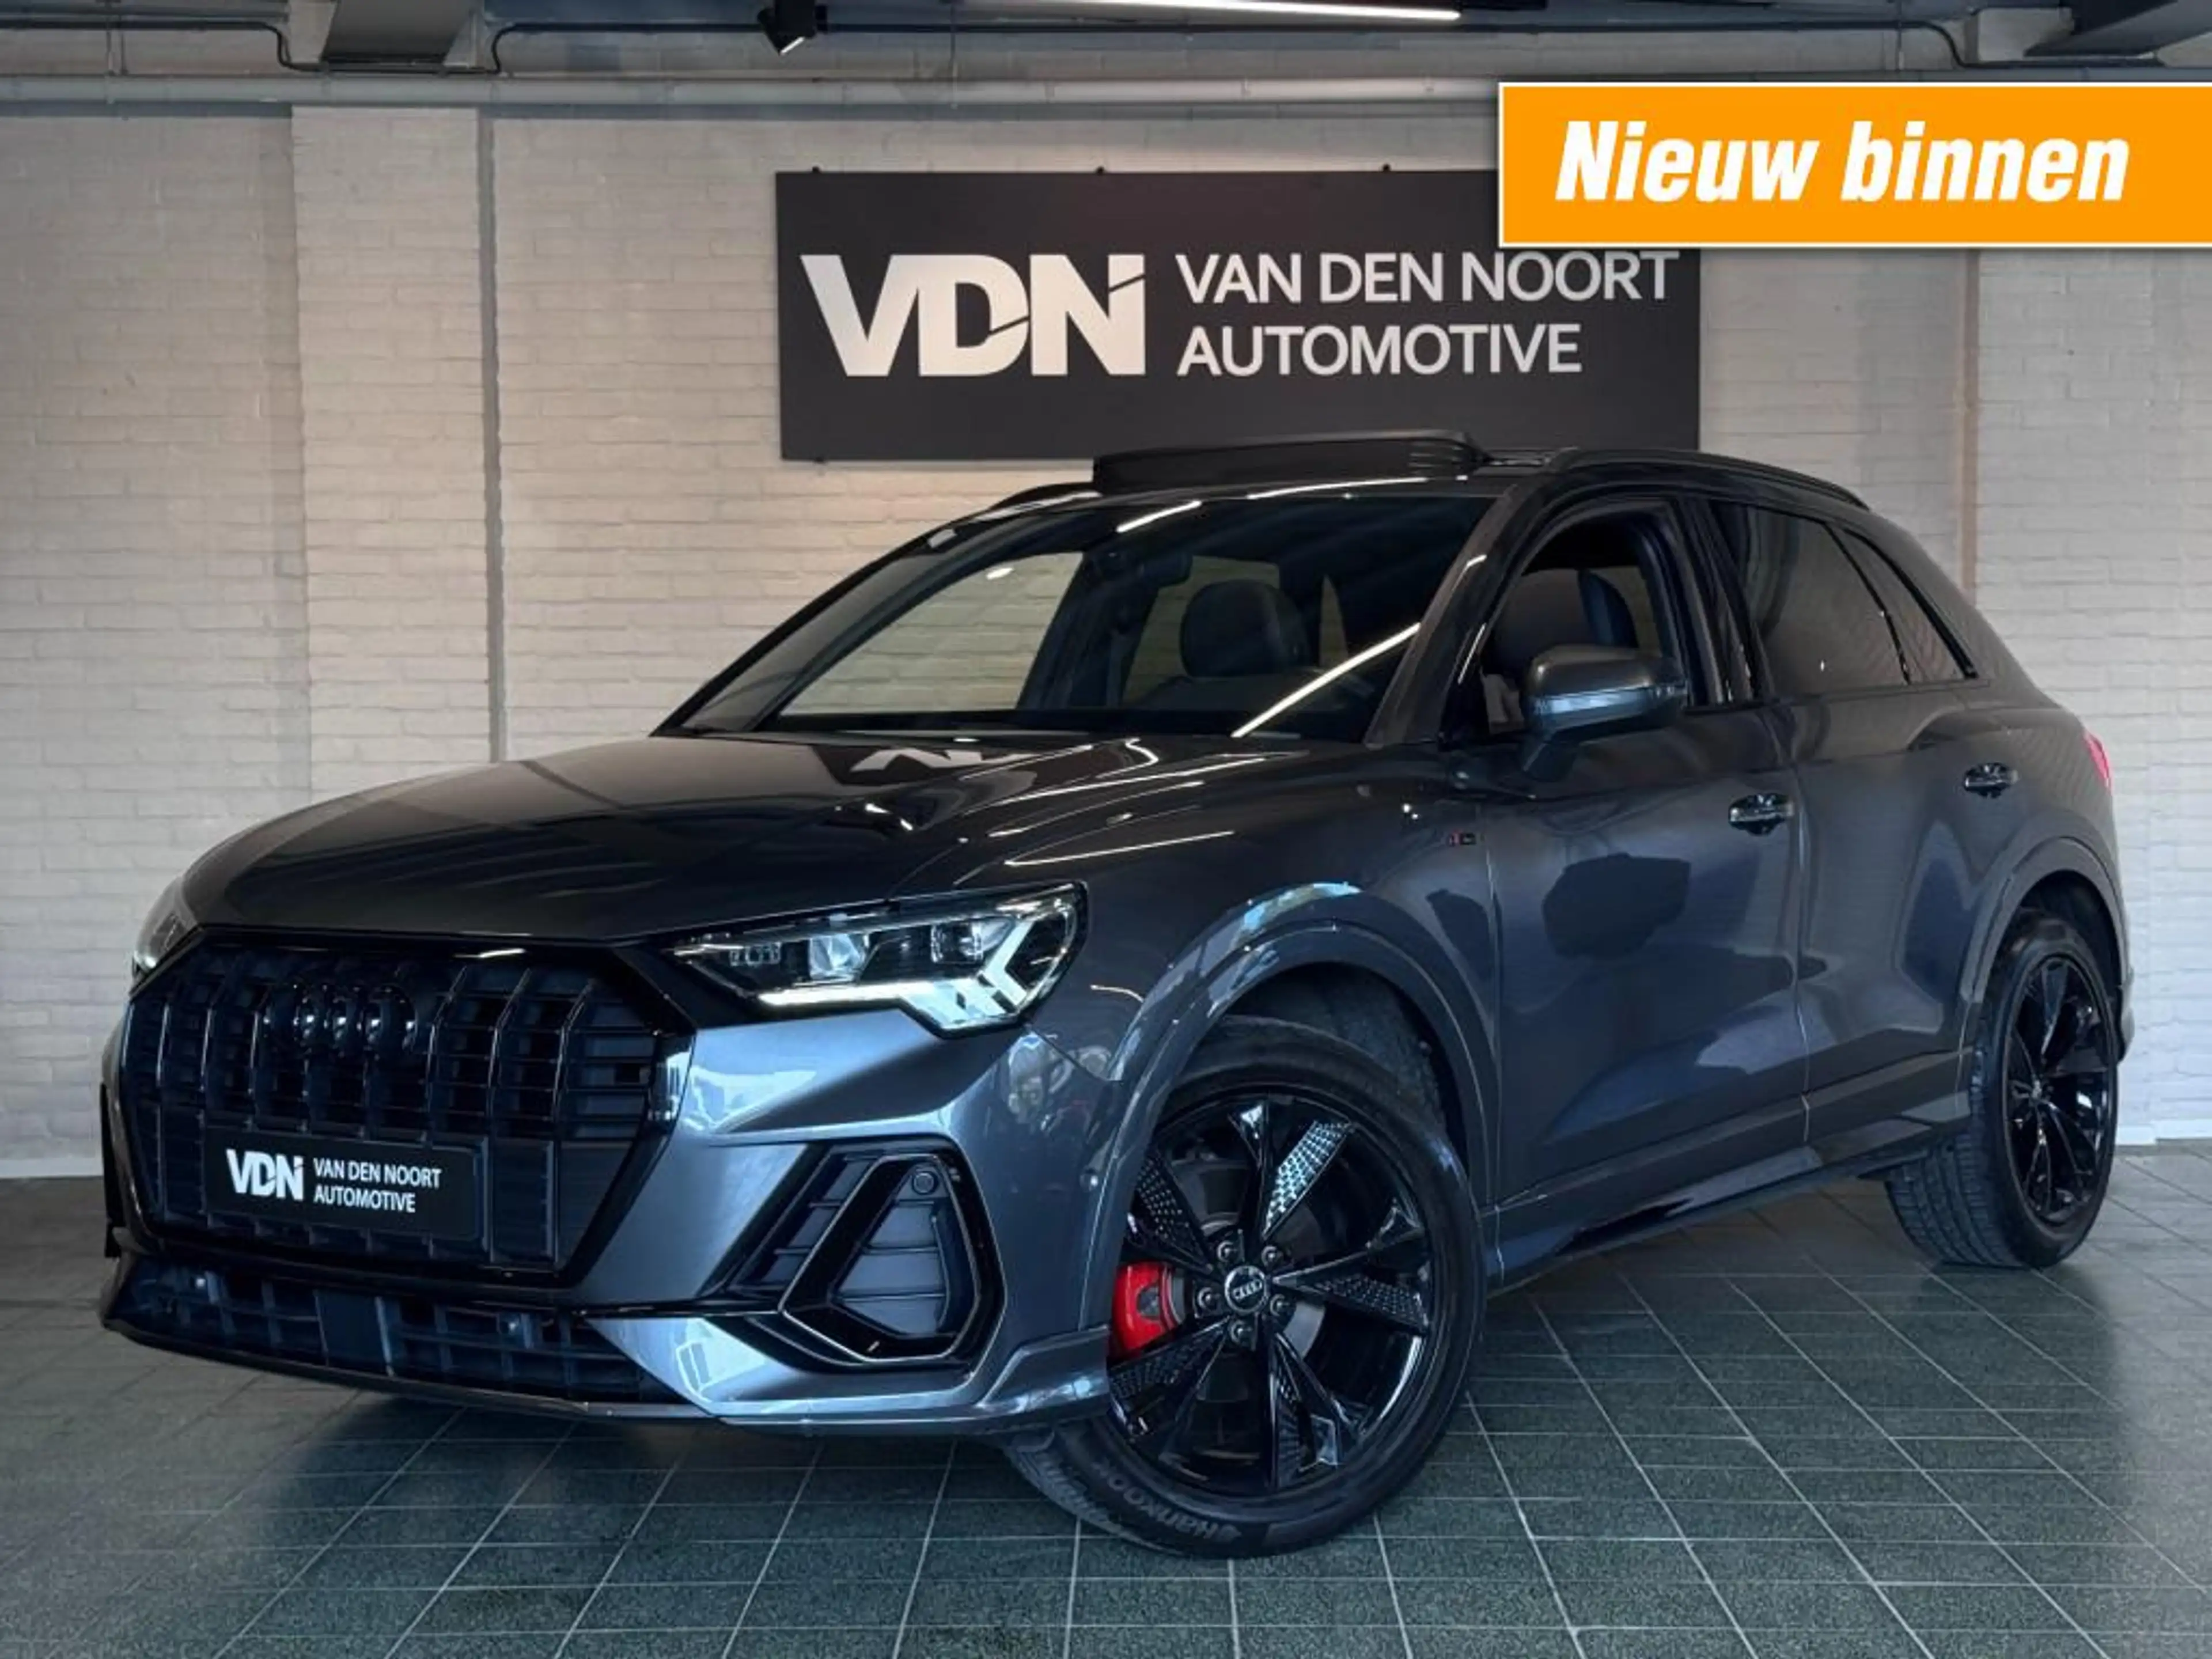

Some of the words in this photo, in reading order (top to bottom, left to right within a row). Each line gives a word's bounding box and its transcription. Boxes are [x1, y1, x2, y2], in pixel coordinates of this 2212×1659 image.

[1175, 253, 1301, 304] VAN
[1320, 253, 1443, 302] DEN
[1461, 250, 1680, 302] NOORT
[801, 253, 1146, 376] VDN
[1176, 323, 1581, 376] AUTOMOTIVE
[226, 1149, 304, 1201] VDN
[312, 1184, 416, 1213] AUTOMOTIVE
[313, 1157, 344, 1180] VAN
[347, 1160, 381, 1183] DEN
[384, 1165, 442, 1189] NOORT
